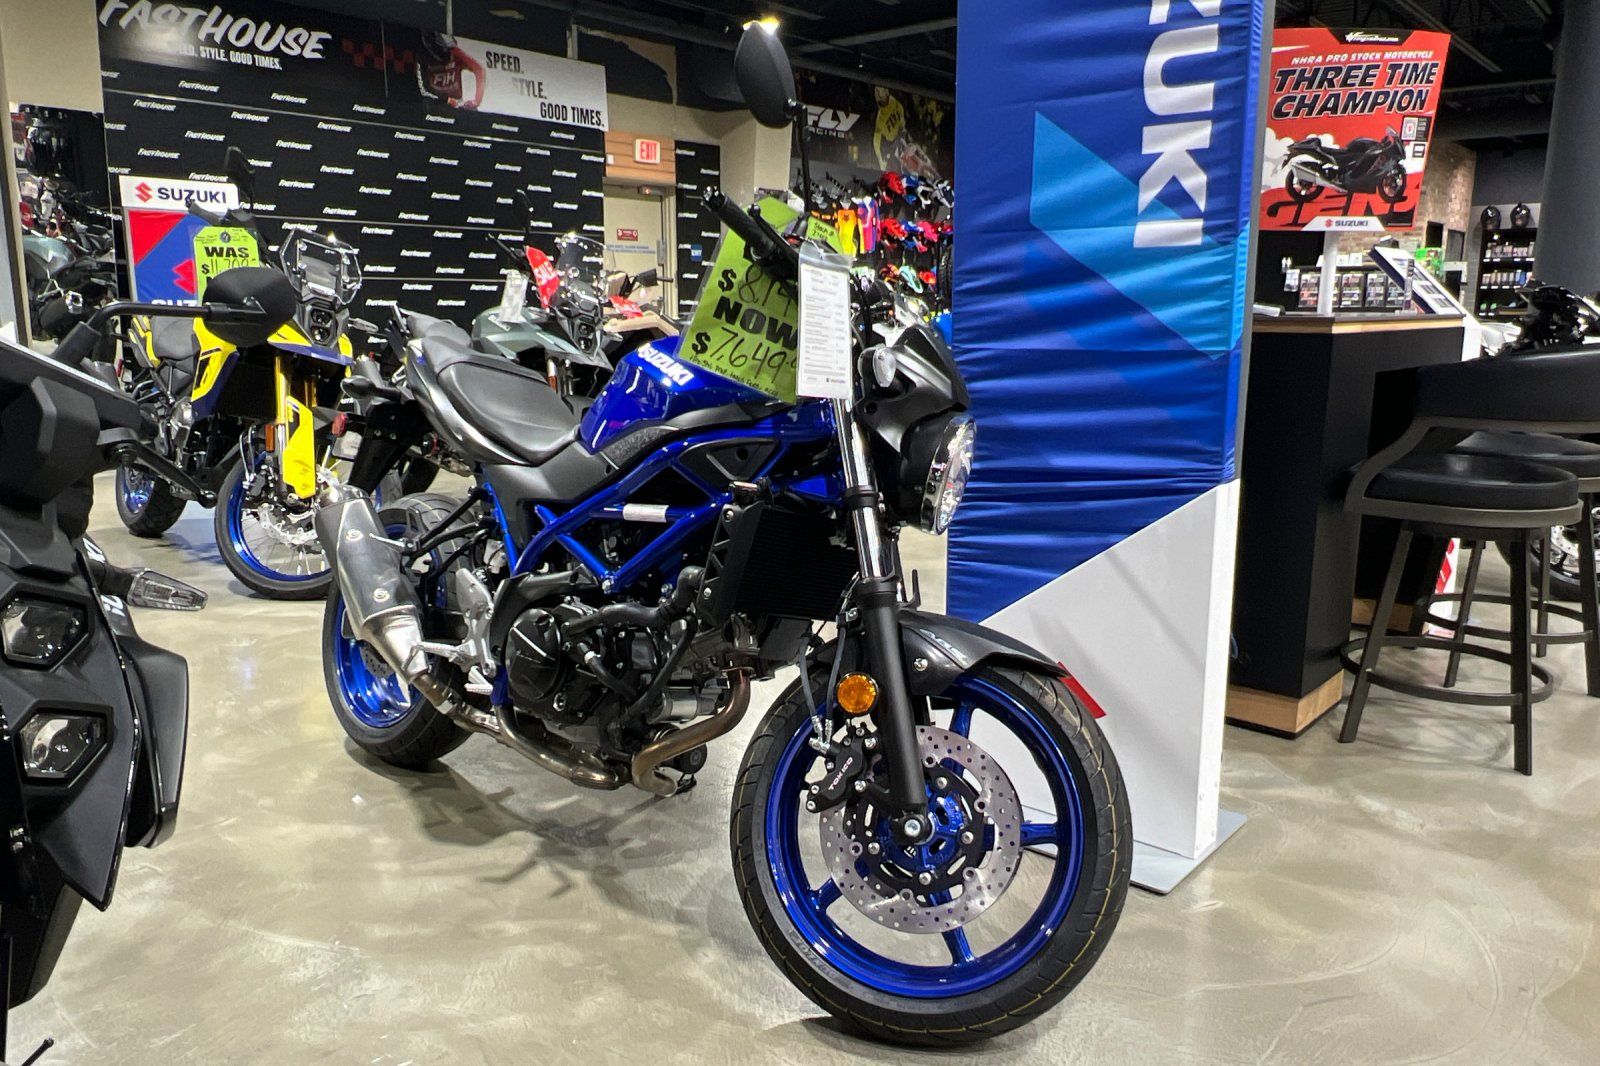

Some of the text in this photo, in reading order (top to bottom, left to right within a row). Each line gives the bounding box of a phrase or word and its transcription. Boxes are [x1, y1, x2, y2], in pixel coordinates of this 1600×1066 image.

[200, 46, 228, 62] STYLE.
[229, 50, 253, 66] GOOD
[253, 54, 283, 71] TIMES.
[485, 50, 524, 74] SPEED.
[1291, 51, 1434, 65] NHRA PRO STOCK MOTORCYCLE
[1274, 61, 1439, 94] THREE TIME
[540, 102, 605, 127] GOOD TIMES.
[1272, 87, 1430, 120] CHAMPION
[807, 105, 861, 132] FLY
[640, 141, 658, 161] EXIT
[157, 187, 227, 204] SUZUKI
[204, 246, 250, 258] WAS
[713, 295, 798, 352] NOW
[637, 342, 695, 386] SUZUKI
[828, 757, 853, 790] TOKICO
